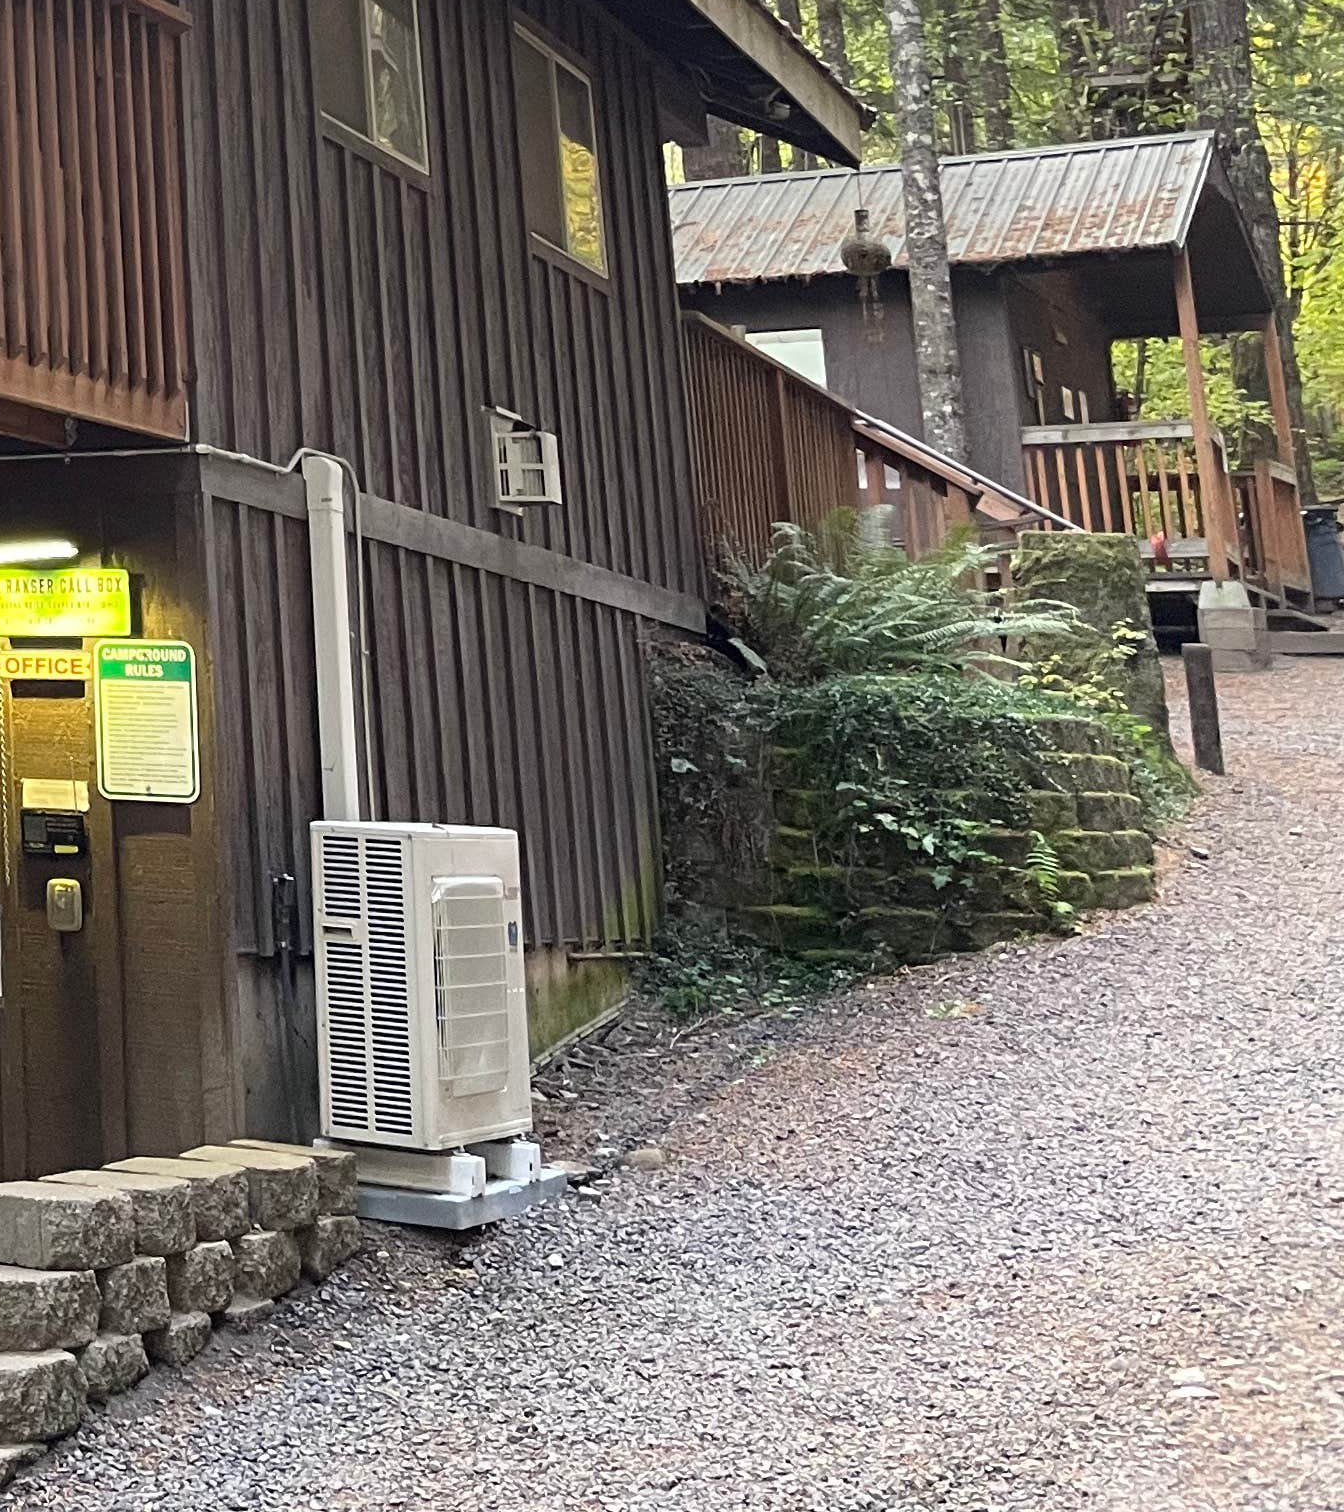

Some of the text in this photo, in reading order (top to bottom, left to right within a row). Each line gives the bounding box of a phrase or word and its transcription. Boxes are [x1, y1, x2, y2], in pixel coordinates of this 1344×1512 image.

[60, 578, 93, 593] CALL
[97, 577, 123, 593] BOX
[101, 647, 187, 663] CAMPGROUND
[4, 657, 84, 675] OFFICE
[124, 663, 165, 678] RULES
